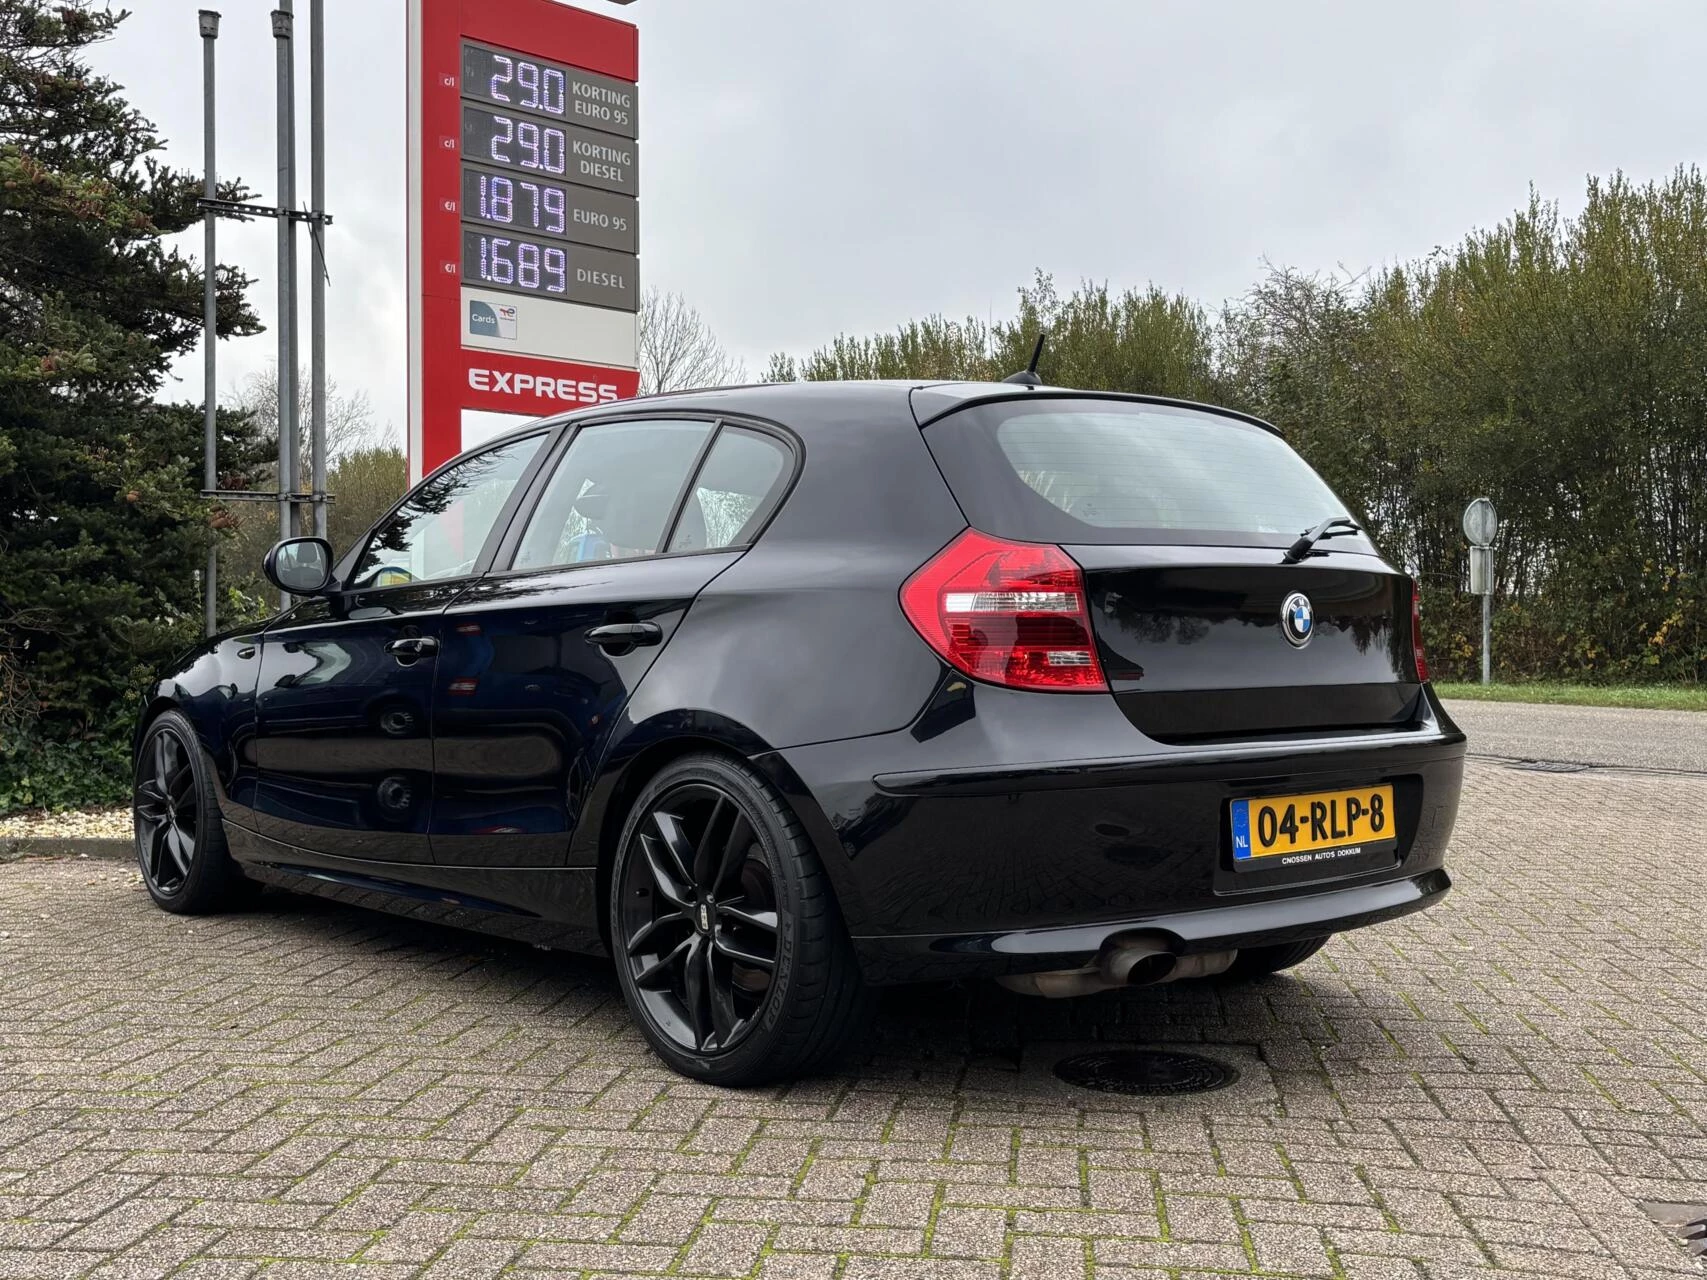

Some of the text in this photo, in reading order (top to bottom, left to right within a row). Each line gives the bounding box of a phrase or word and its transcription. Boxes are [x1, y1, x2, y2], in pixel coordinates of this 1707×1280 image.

[491, 55, 564, 114] 29.0
[572, 81, 631, 108] KORTING
[574, 101, 629, 126] EURO 95
[491, 116, 564, 174] 29.0
[572, 141, 631, 166] KORTING
[580, 161, 624, 182] DIESEL
[480, 175, 565, 233] 1.879
[573, 209, 627, 231] EURO 95
[480, 237, 565, 293] 1.689
[577, 268, 625, 289] DIESEL
[472, 313, 496, 324] Cards
[468, 368, 618, 404] EXPRESS
[1258, 793, 1385, 848] 04-RLP-8
[1235, 835, 1249, 849] NL
[1282, 853, 1312, 864] CNOSSEN
[1337, 847, 1361, 857] DOKKUM
